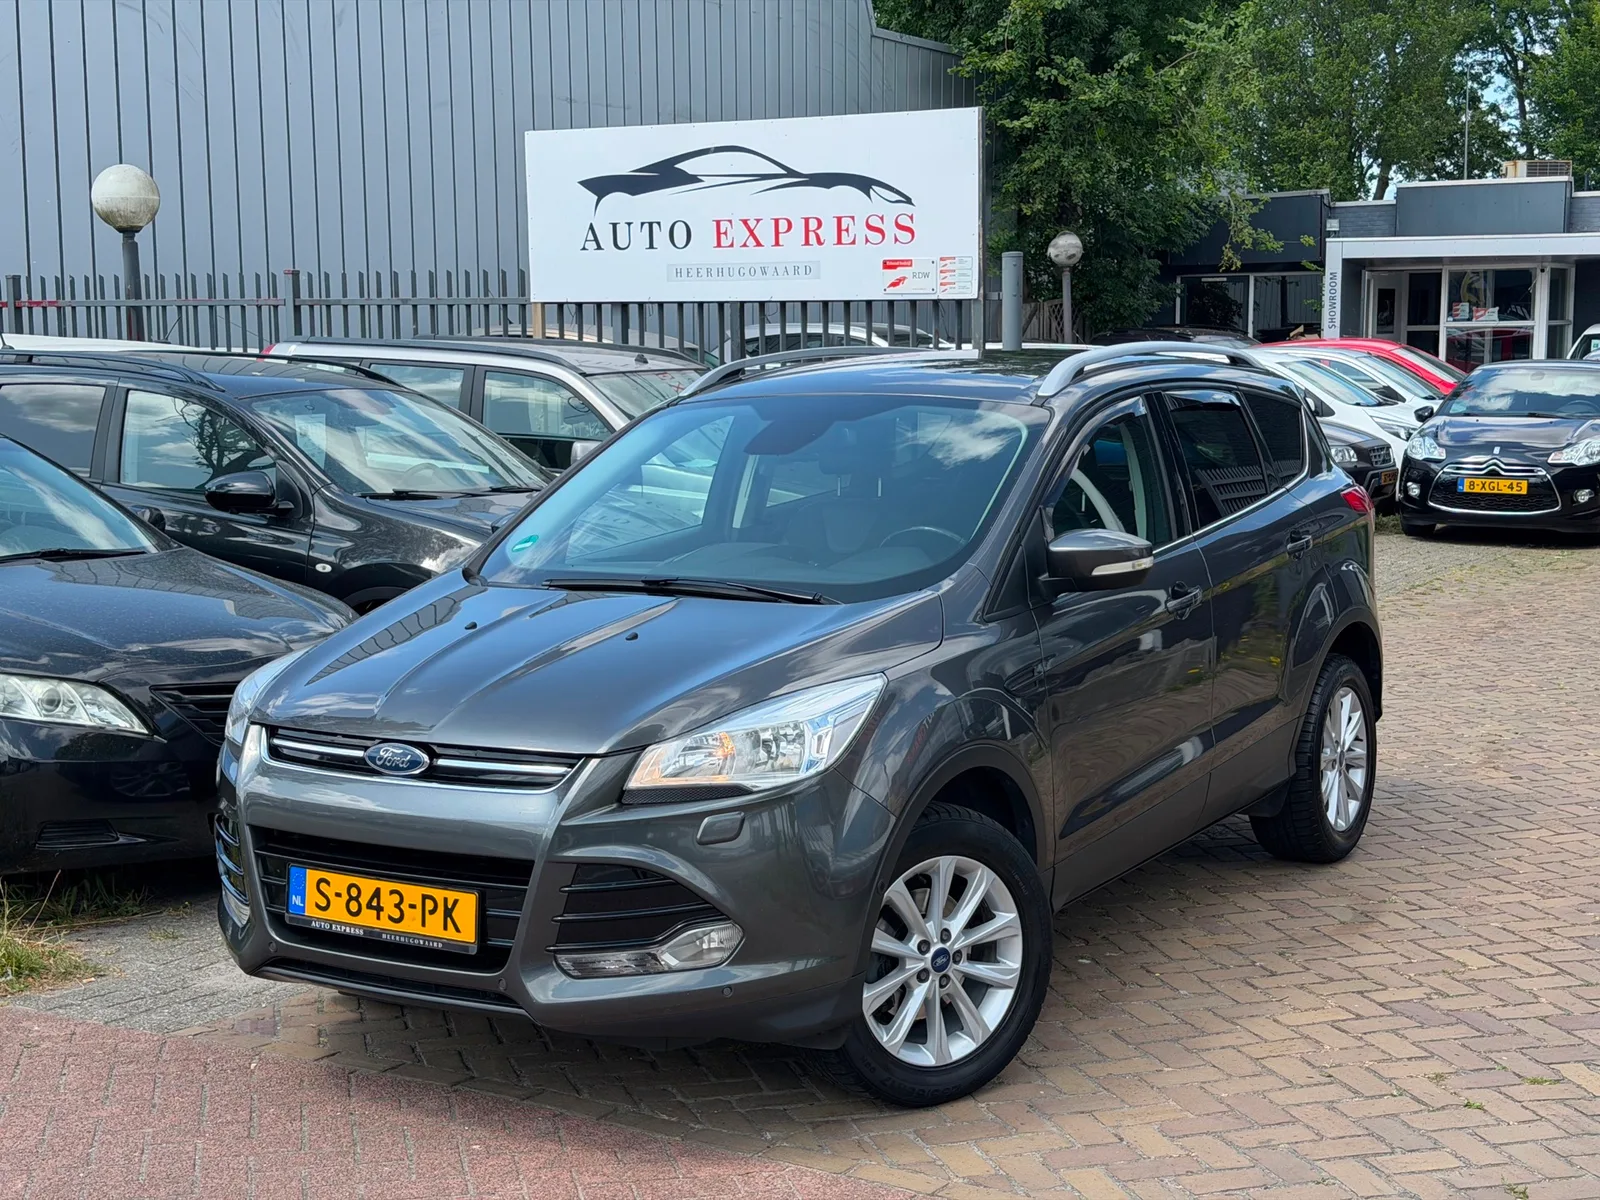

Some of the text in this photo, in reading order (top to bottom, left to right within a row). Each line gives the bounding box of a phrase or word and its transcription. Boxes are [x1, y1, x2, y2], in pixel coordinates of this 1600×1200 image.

[580, 213, 916, 251] AUTO EXPRESS
[675, 264, 813, 279] HEERHUGOWAARD
[912, 271, 930, 279] RDW
[1327, 271, 1338, 330] SHOWROOM
[1468, 480, 1523, 492] 8-XGL-45
[375, 746, 412, 768] Ford
[291, 894, 304, 907] NL
[314, 877, 462, 934] S-843-PK
[310, 920, 443, 949] AUTO EXPRESS HEERHUGOWAARD
